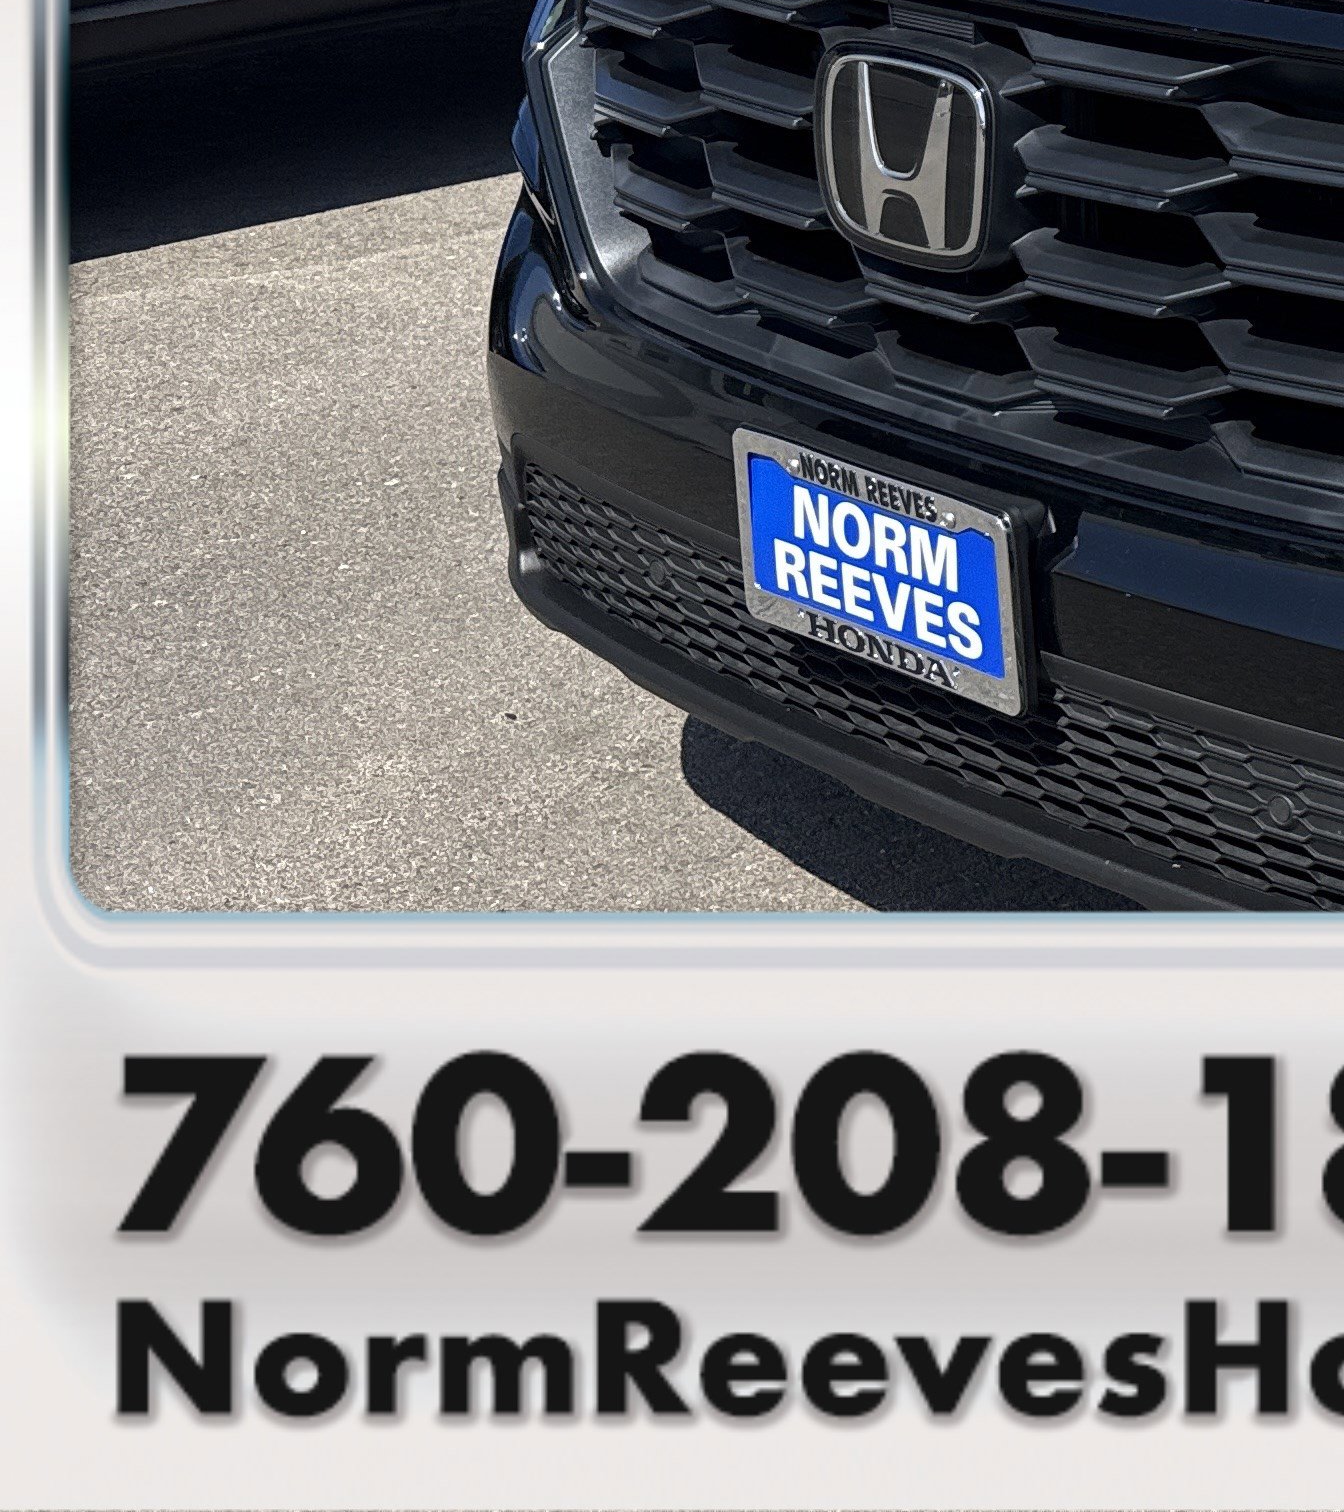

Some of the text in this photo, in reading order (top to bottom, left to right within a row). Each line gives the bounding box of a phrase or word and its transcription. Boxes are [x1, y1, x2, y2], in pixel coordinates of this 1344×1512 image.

[797, 451, 939, 524] NORM REEVES
[792, 484, 959, 594] NORM
[772, 537, 984, 661] REEVES
[804, 611, 959, 689] HONDA
